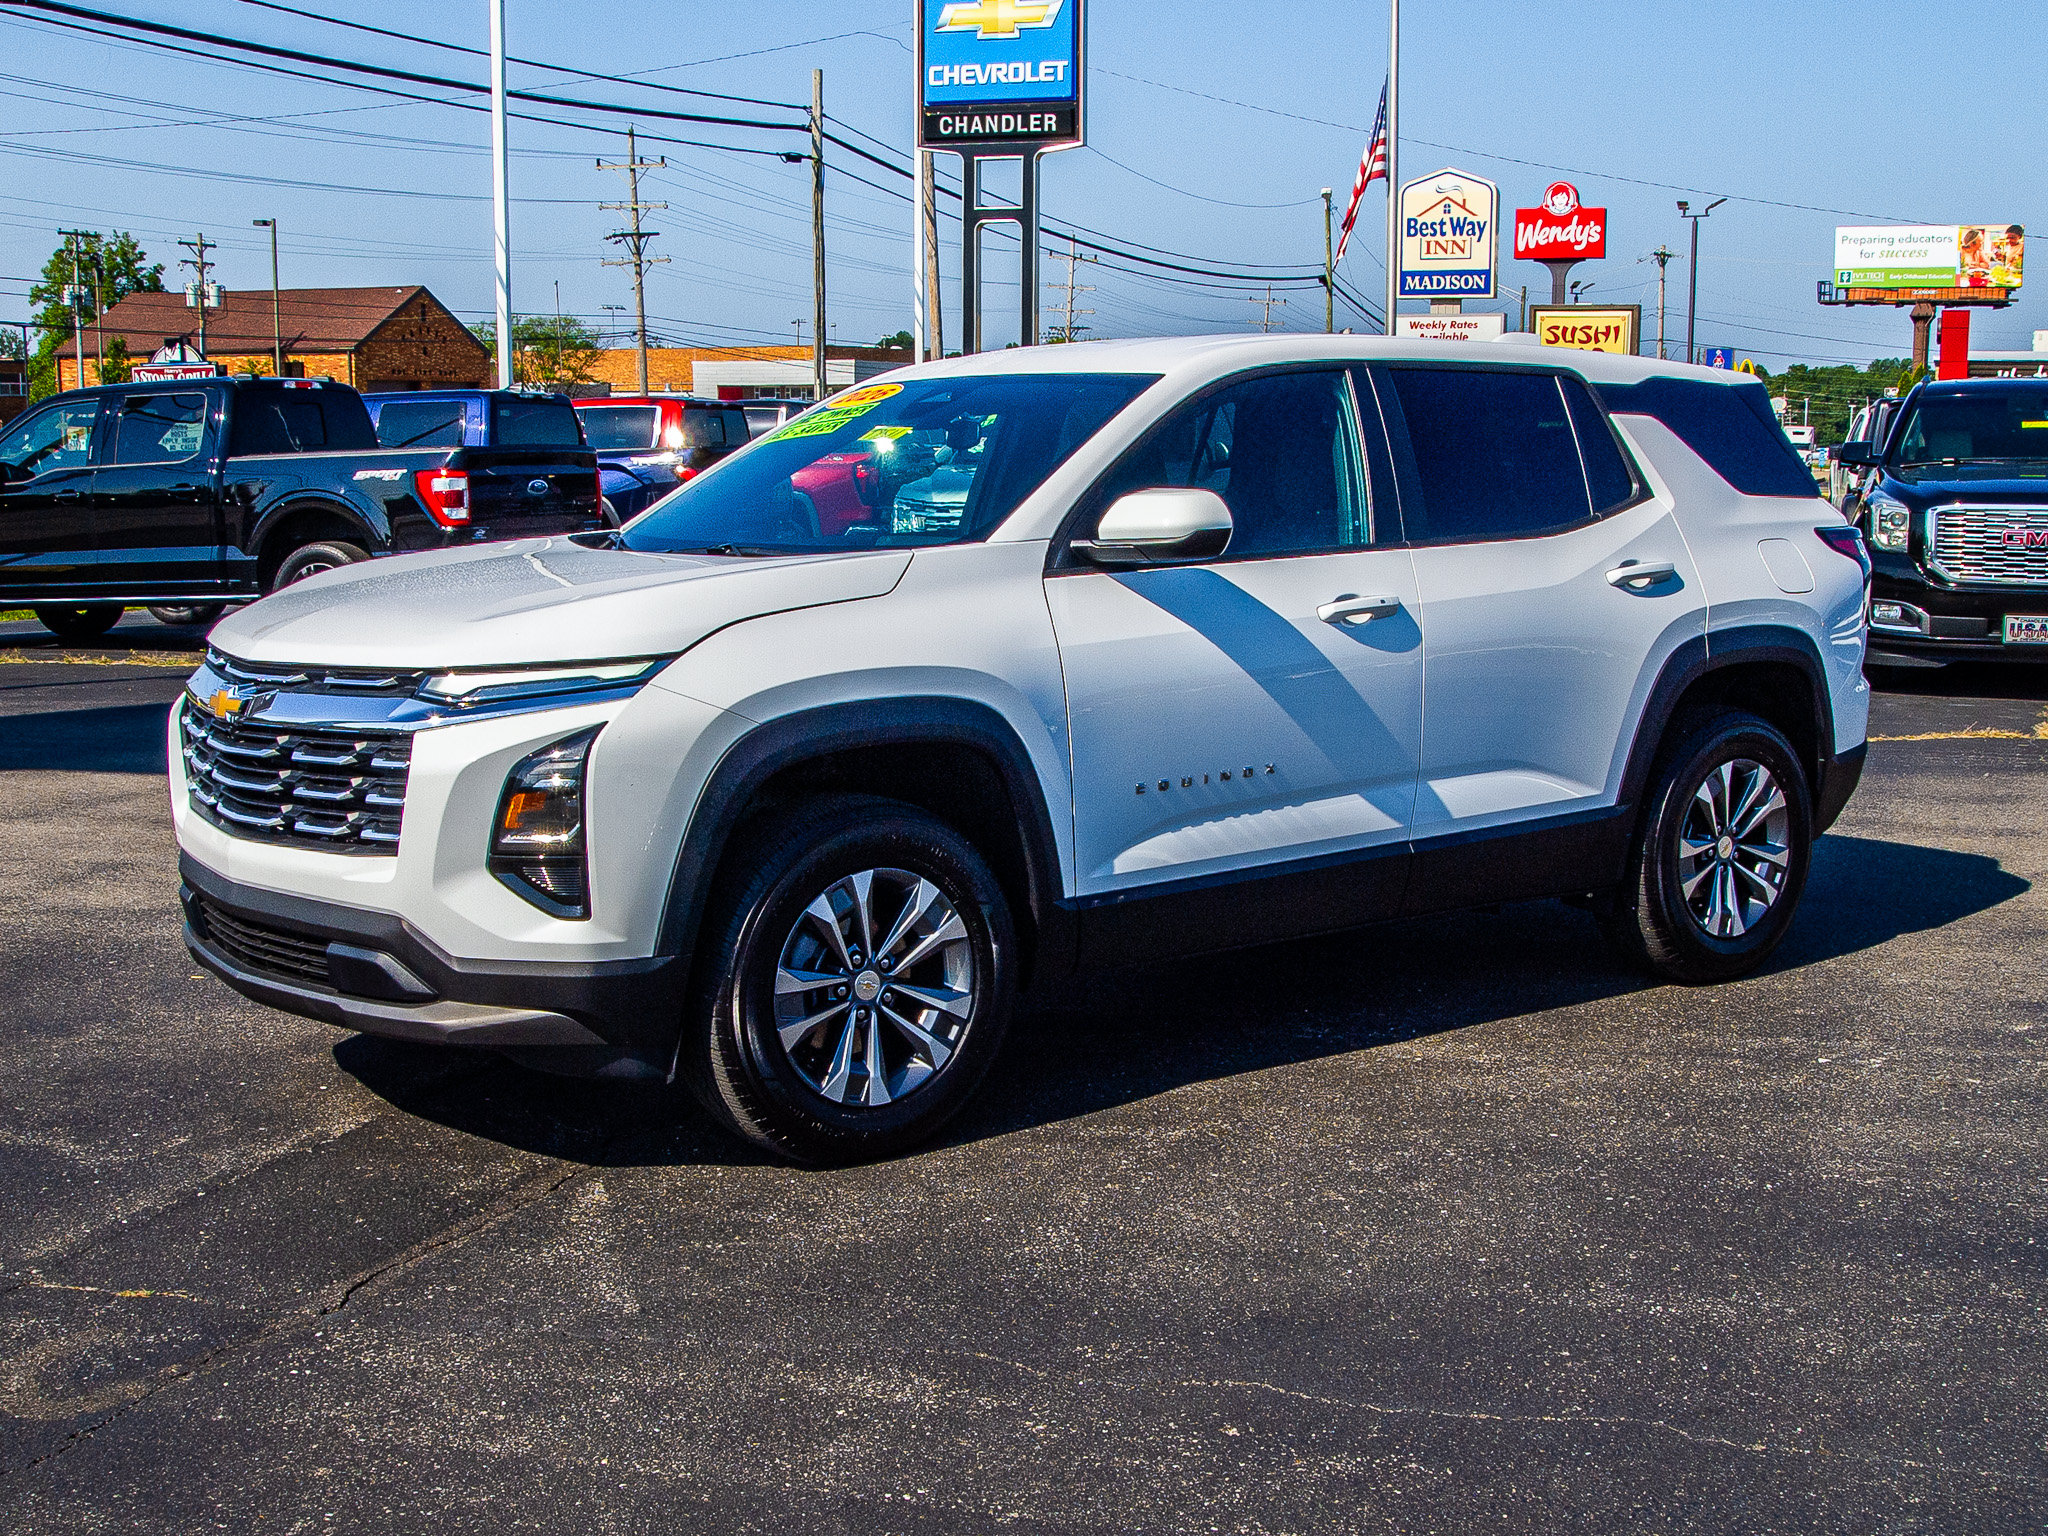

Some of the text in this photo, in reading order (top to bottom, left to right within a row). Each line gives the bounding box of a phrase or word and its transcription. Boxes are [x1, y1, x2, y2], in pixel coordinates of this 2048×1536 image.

[928, 60, 1069, 87] CHEVROLET
[939, 113, 1058, 135] CHANDLER
[1406, 216, 1488, 243] Best Way
[1517, 214, 1602, 252] Wendy's
[1841, 233, 1953, 246] Preparing educators
[1423, 239, 1467, 256] INN
[1859, 248, 1929, 259] for success
[1404, 274, 1487, 291] MADISON
[1409, 320, 1479, 332] Weekly Rates
[1545, 325, 1621, 345] SUSHI
[1134, 760, 1277, 795] EQUINOX
